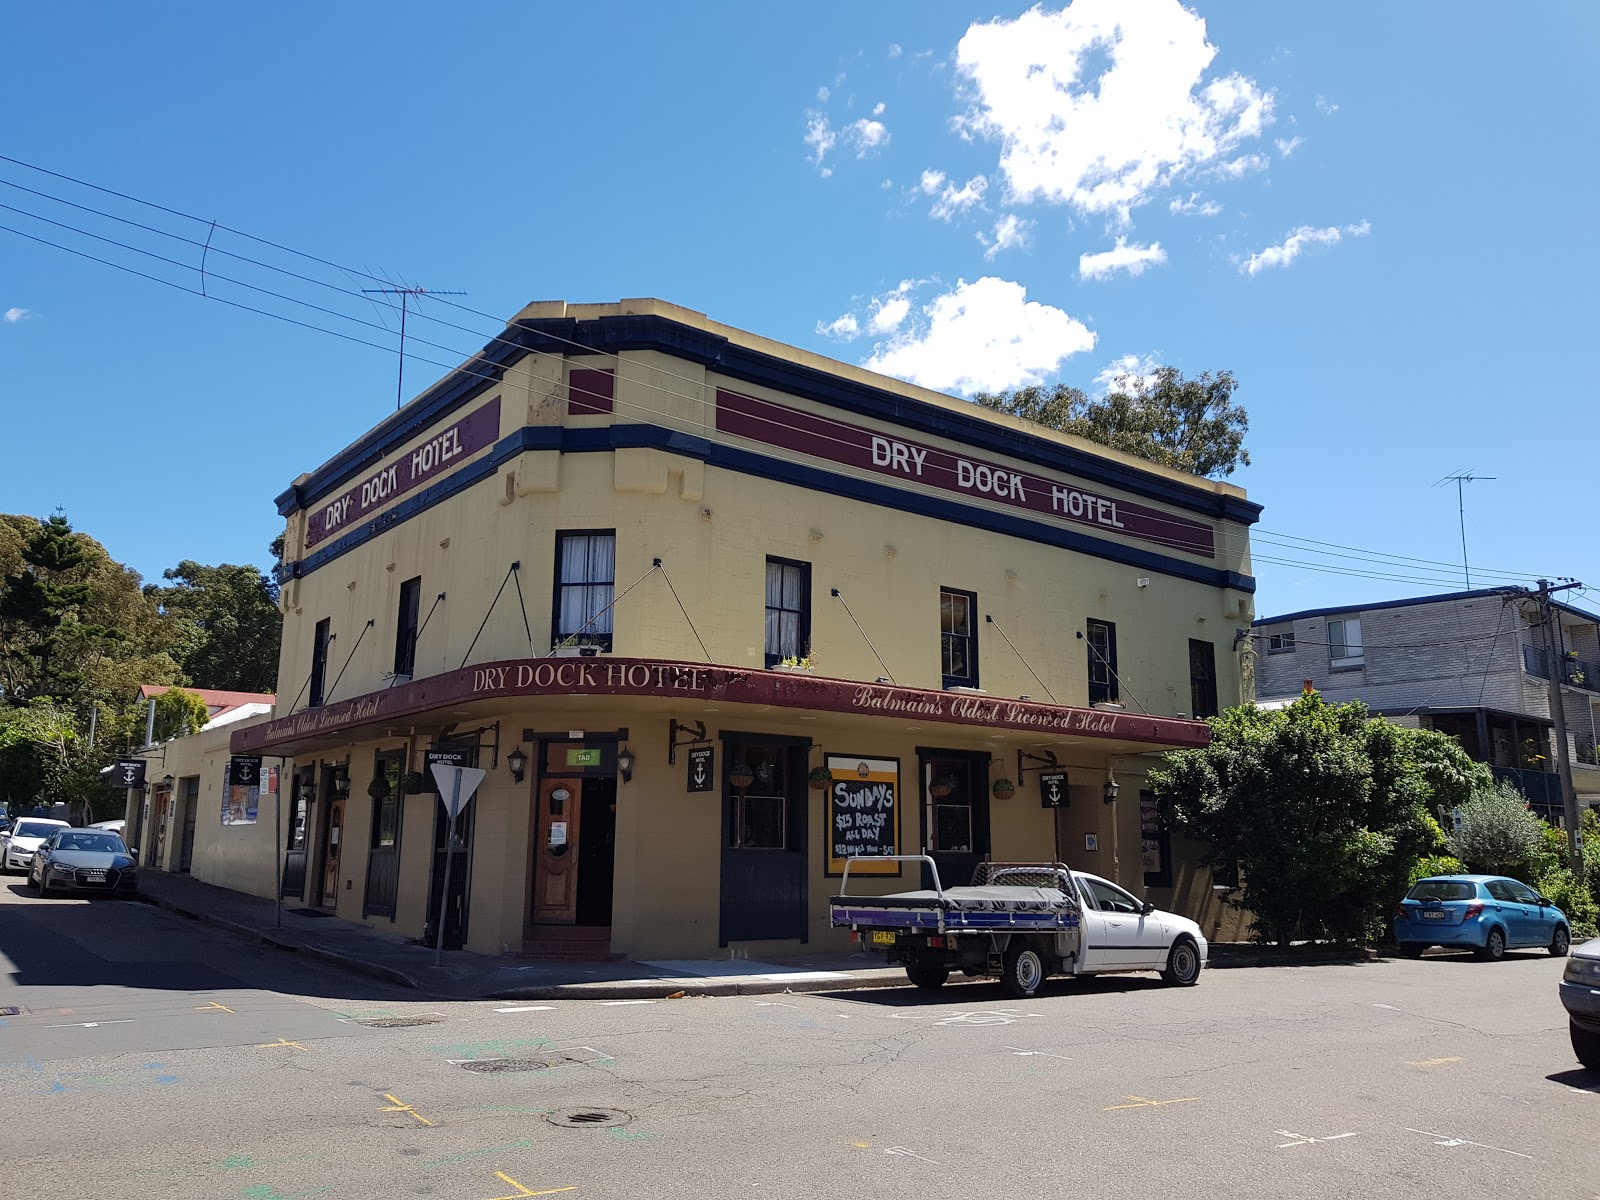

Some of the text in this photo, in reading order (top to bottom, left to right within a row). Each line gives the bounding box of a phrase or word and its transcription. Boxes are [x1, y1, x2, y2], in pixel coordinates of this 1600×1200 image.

[325, 427, 463, 530] DRY DOCK HOTEL
[871, 436, 1124, 528] DRY DOCK HOTEL
[473, 666, 511, 692] DRY
[515, 663, 598, 688] DOCK
[319, 708, 354, 728] Licensed
[354, 695, 380, 720] Hotel
[852, 685, 943, 716] Balmain's
[950, 697, 999, 722] Oldest
[1075, 712, 1118, 733] Hotel
[834, 782, 894, 812] SUNDAYS
[835, 812, 887, 831] $15 ROAST
[846, 826, 880, 841] ALL DAY
